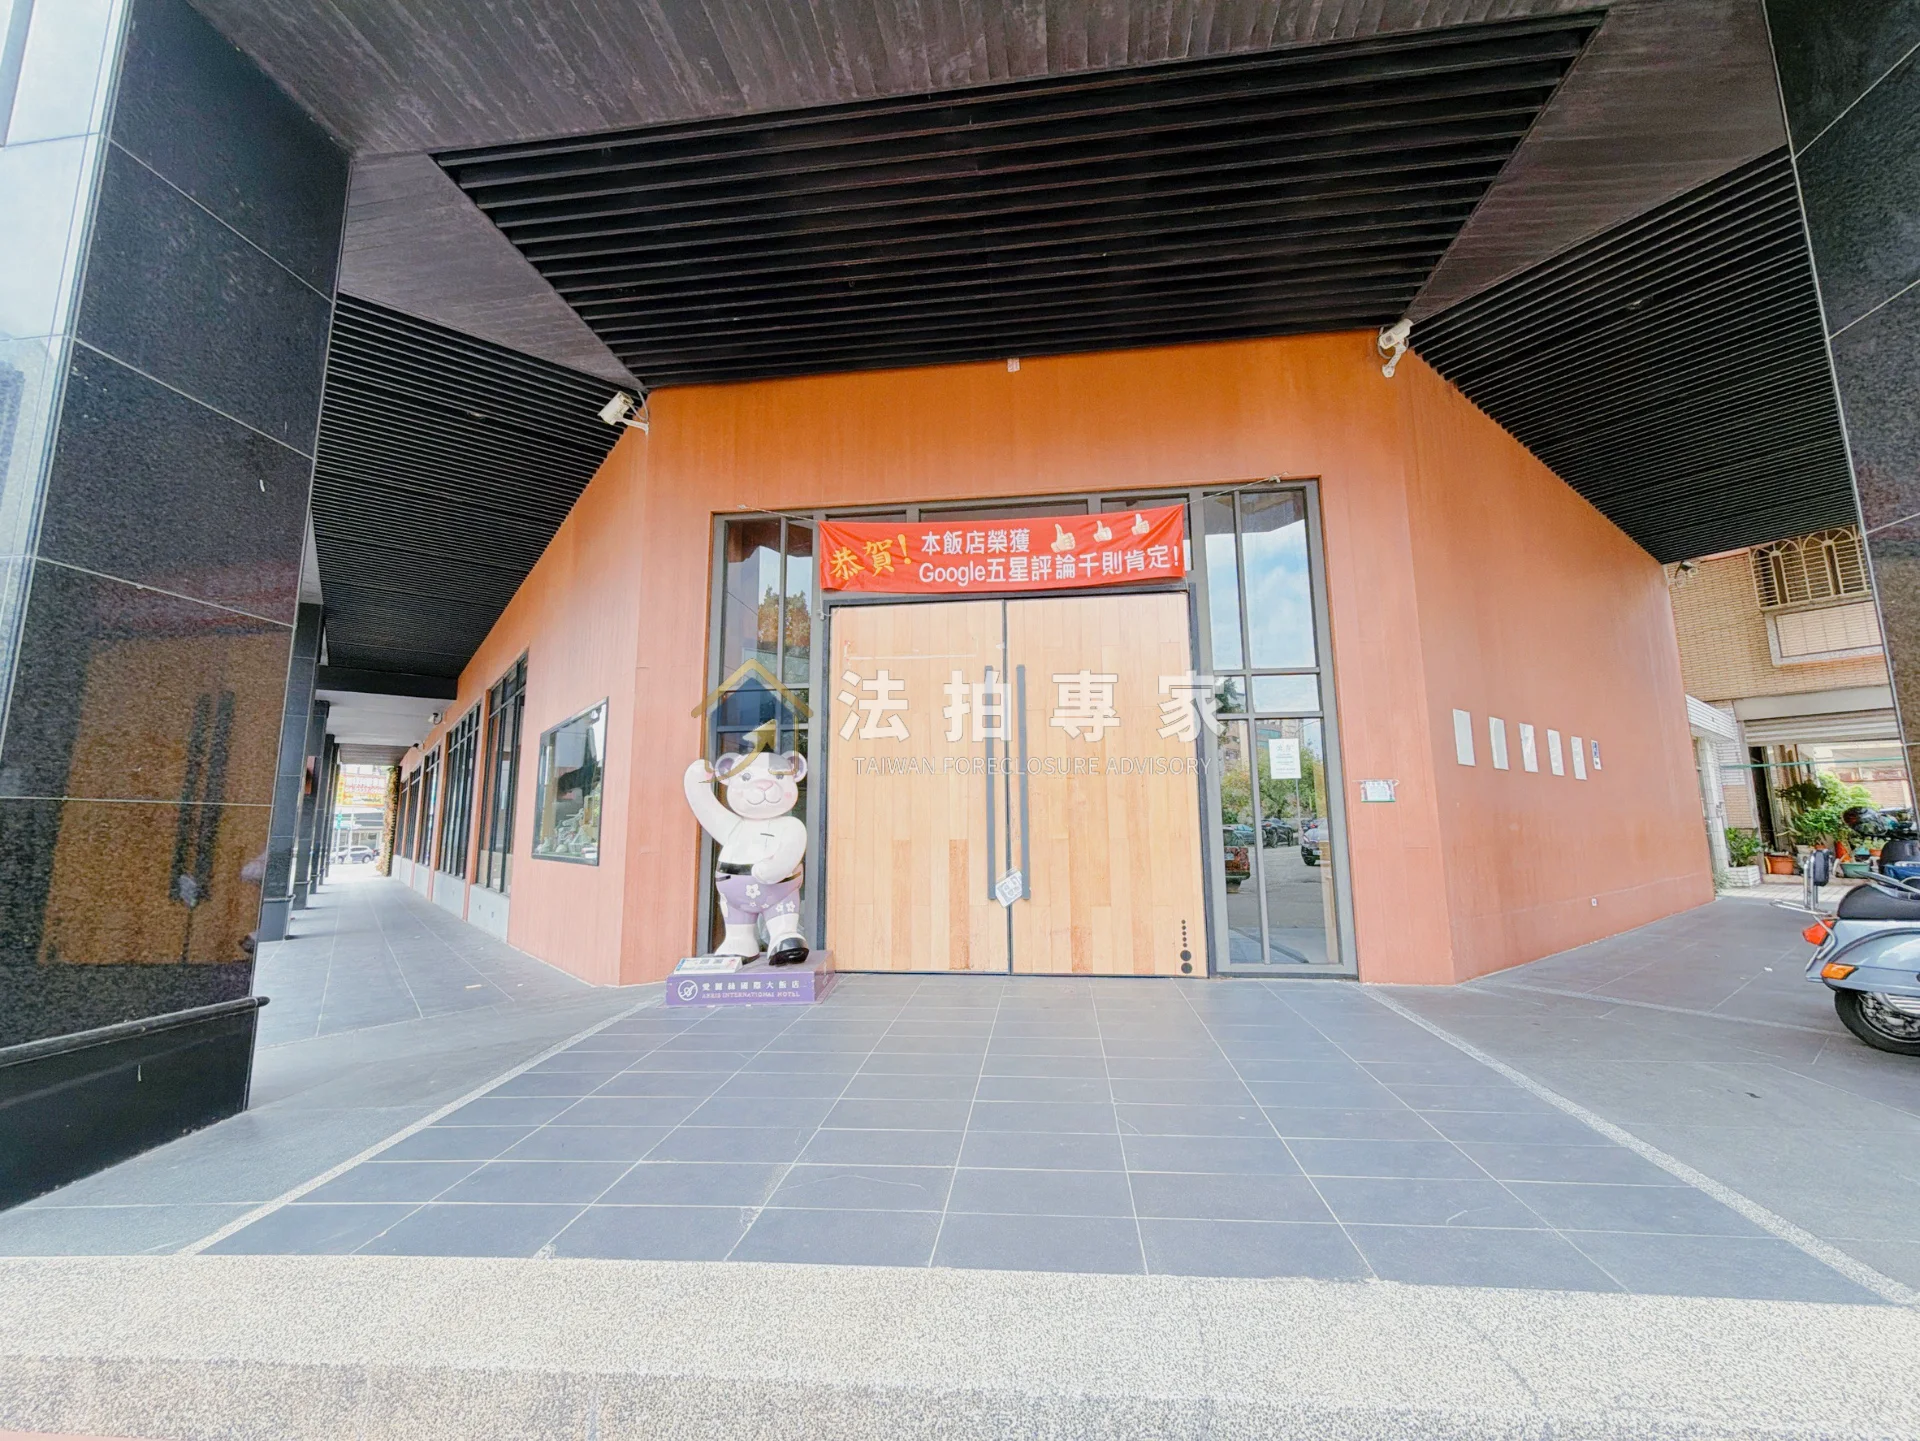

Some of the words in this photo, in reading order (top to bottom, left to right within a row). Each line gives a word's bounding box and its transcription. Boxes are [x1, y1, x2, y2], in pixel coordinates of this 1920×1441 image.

[921, 528, 1031, 556] 本飯店榮獲
[918, 544, 1180, 587] Google五星評論千則肯定!
[722, 991, 774, 999] INTERNATIONAL
